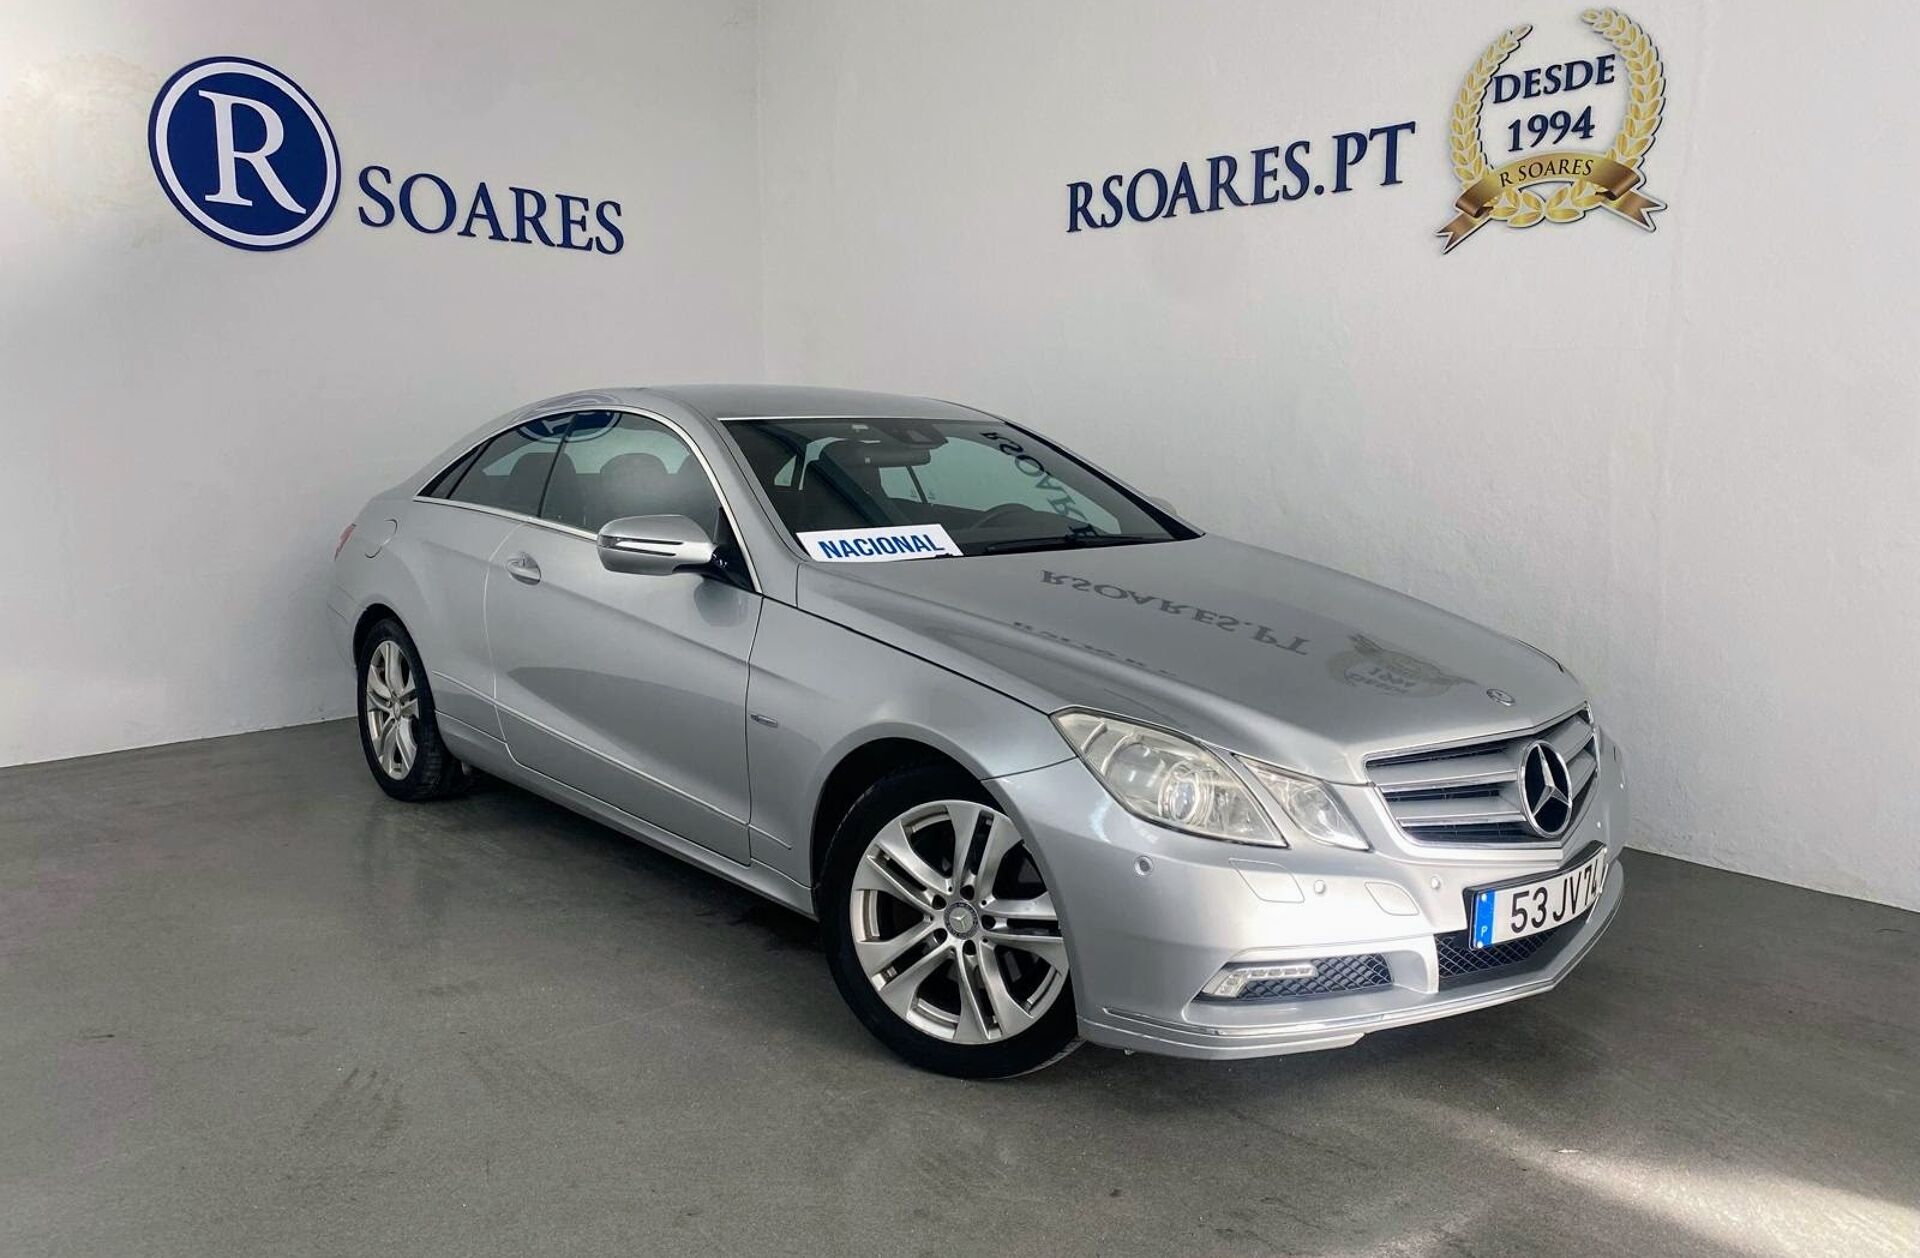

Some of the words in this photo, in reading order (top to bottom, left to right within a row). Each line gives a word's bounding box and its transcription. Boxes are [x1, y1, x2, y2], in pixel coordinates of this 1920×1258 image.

[1493, 54, 1616, 104] DESDE
[1508, 105, 1595, 152] 1994
[198, 89, 306, 215] R
[358, 165, 625, 255] SOARES
[1066, 121, 1416, 233] RSOARES.PT
[1500, 171, 1513, 188] R
[1518, 159, 1594, 181] SOARES
[818, 534, 945, 559] NACIONAL
[1510, 886, 1549, 934] 53
[1552, 871, 1582, 922] JV
[1480, 925, 1488, 937] P
